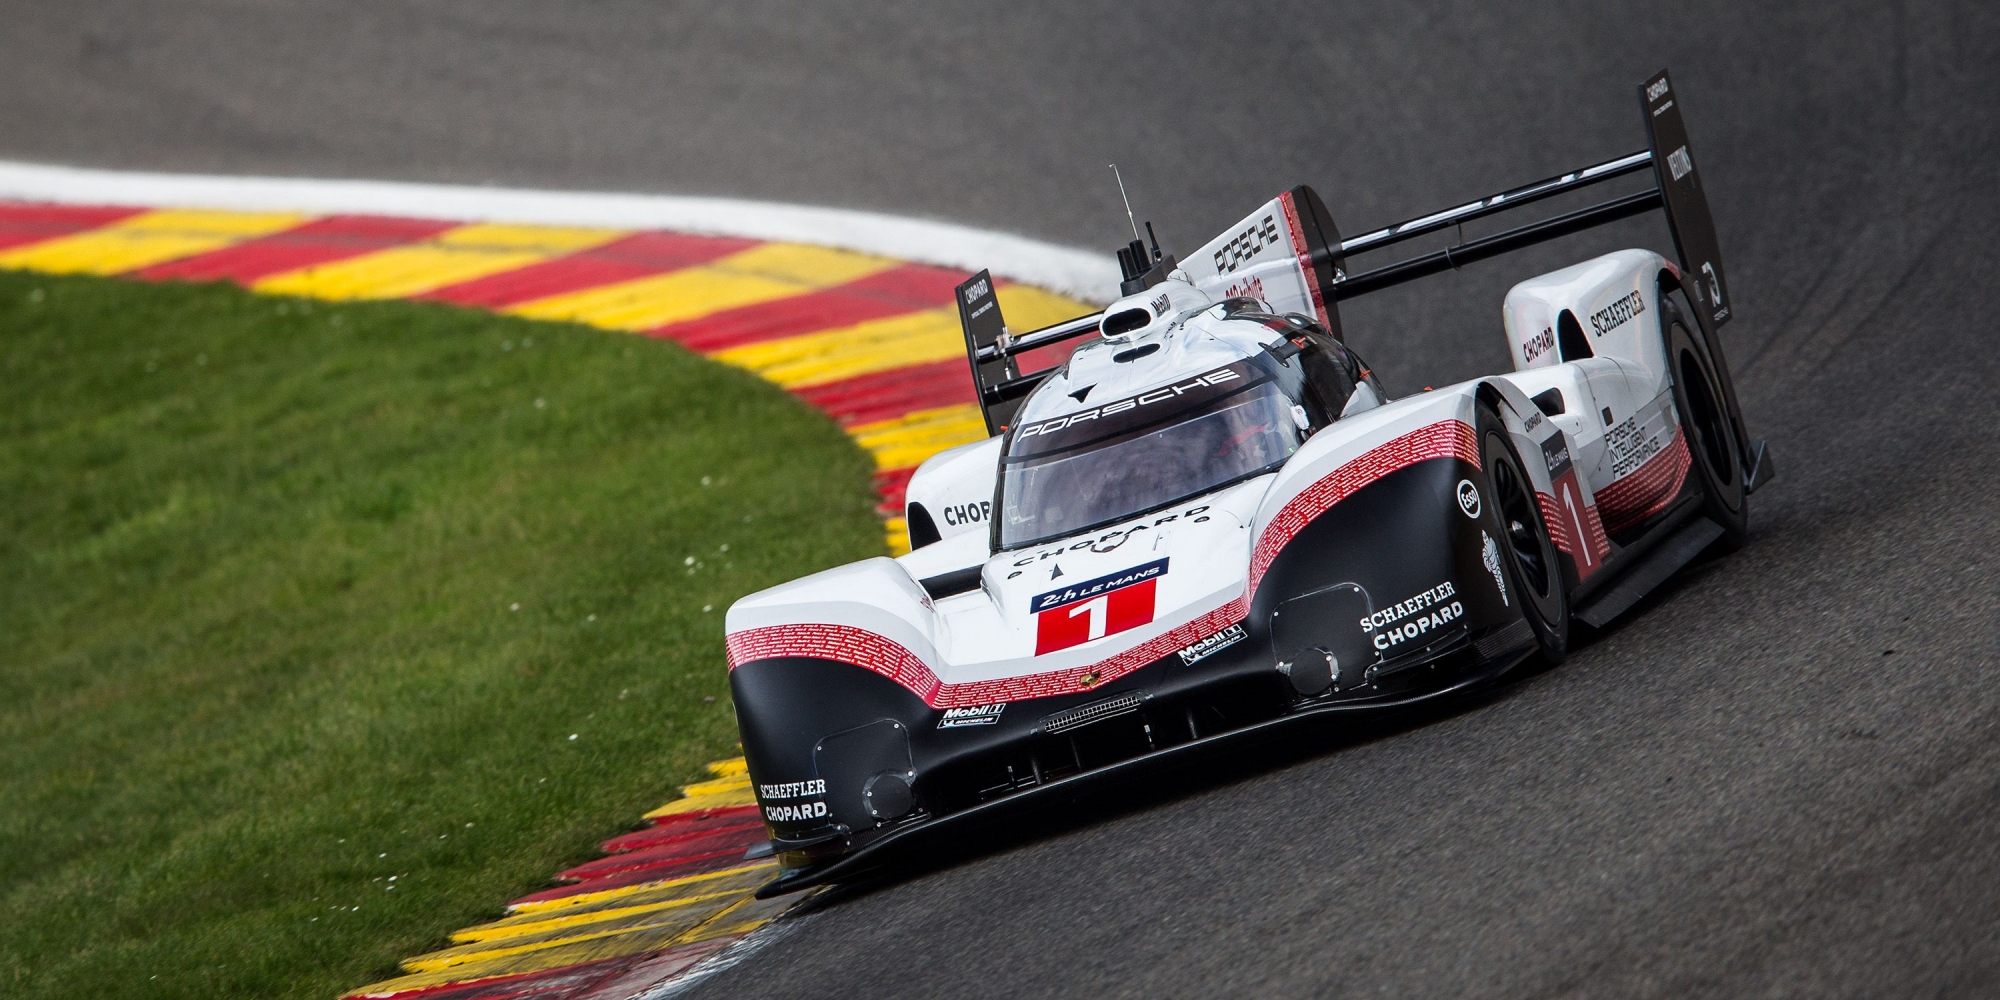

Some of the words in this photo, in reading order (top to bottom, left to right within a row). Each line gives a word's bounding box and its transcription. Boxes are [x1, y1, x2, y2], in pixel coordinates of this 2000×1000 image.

[1213, 215, 1279, 279] PORSCHE
[1590, 289, 1646, 338] SCHAEFFLER
[1523, 326, 1555, 363] CHOPARD
[1017, 368, 1241, 443] PORSCHE
[1604, 416, 1637, 448] PORSCHE
[1609, 426, 1648, 463] INTELLIGENT
[1612, 436, 1660, 480] PERFORMANCE
[944, 501, 991, 528] CHOP
[1562, 482, 1592, 567] 1
[1013, 506, 1210, 567] CHOPARD
[1080, 583, 1104, 597] LE
[1105, 566, 1160, 590] MANS
[1068, 595, 1109, 641] 1
[1360, 581, 1456, 633] SCHAEFFLER
[1373, 601, 1463, 650] CHOPARD
[1177, 631, 1226, 659] Mobil
[943, 704, 990, 719] Mobil
[760, 779, 827, 799] SCHAEFFLER
[765, 802, 827, 822] CHOPARD
